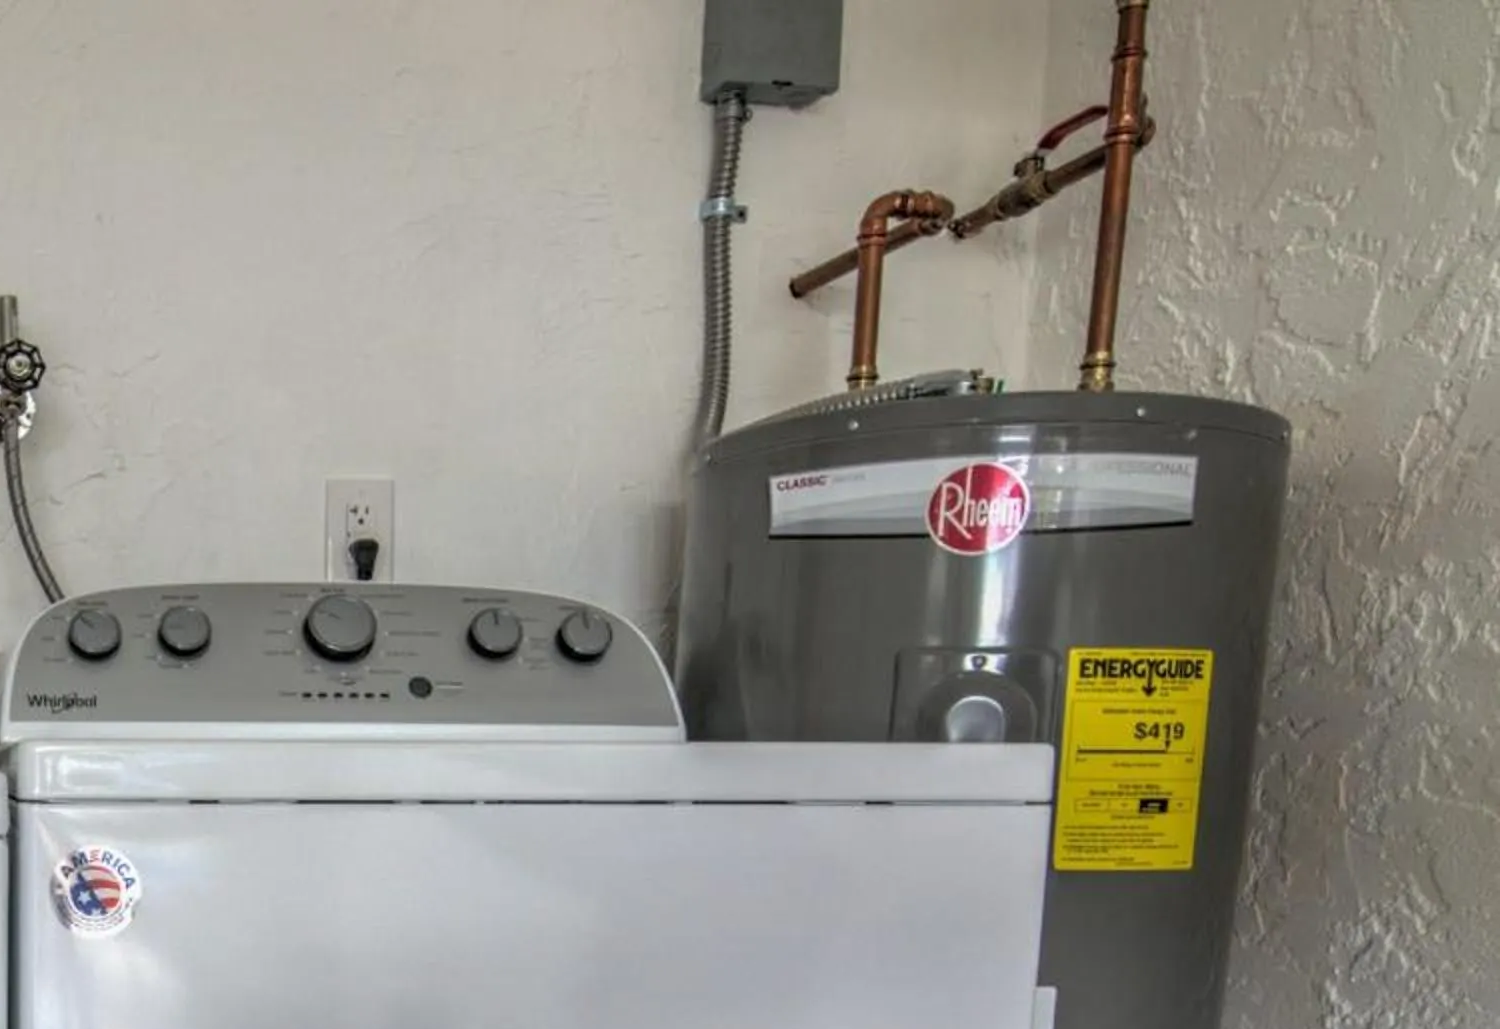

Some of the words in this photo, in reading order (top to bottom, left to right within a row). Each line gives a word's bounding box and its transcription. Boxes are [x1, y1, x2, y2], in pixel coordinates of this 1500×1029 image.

[777, 475, 828, 491] CLASSIC
[938, 466, 1023, 539] Rheem
[1080, 657, 1205, 681] ENERGYGUIDE
[26, 692, 98, 714] Whirlpool
[1133, 721, 1186, 740] $419
[60, 848, 136, 891] AMERICA
